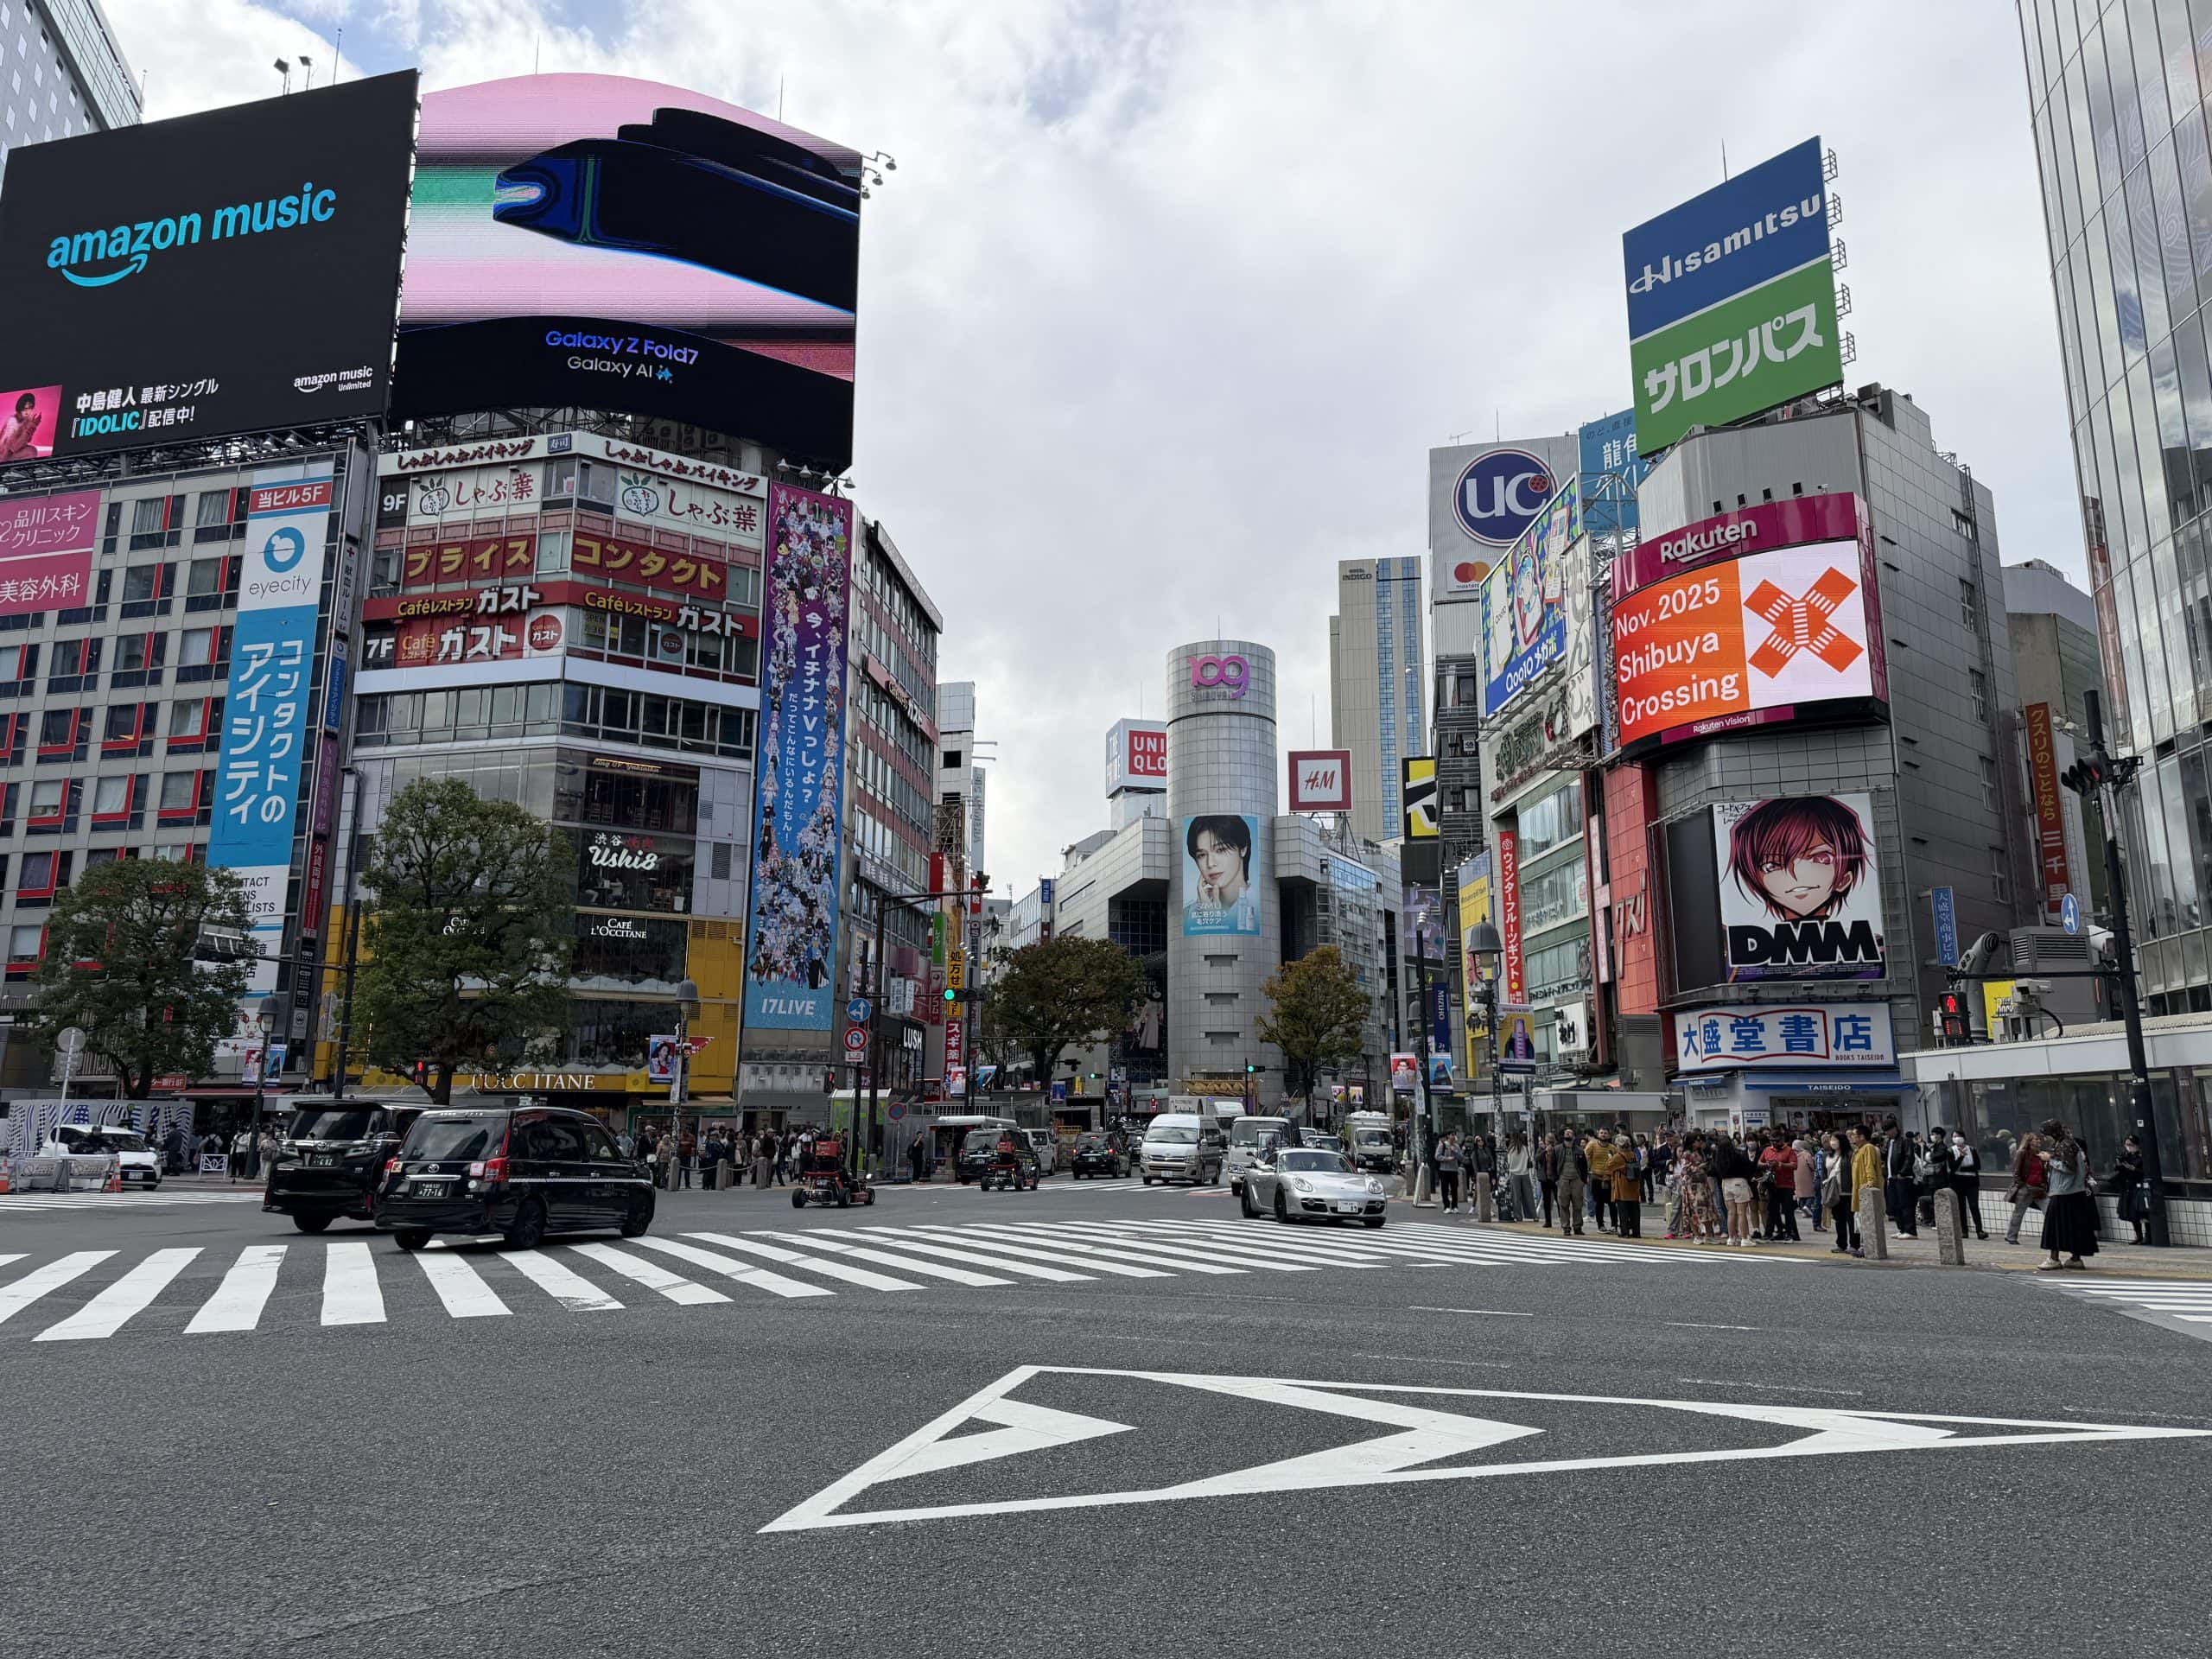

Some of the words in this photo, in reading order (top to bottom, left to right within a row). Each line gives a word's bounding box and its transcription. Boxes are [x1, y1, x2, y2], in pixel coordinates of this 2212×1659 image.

[47, 211, 201, 269] amazon
[212, 182, 337, 239] music
[1630, 193, 1820, 293] Hisamitsu
[546, 330, 623, 355] Galaxy
[626, 336, 639, 353] Z
[643, 340, 700, 365] Fold7
[1644, 302, 1823, 414] サロンパス
[294, 372, 337, 389] amazon
[339, 365, 373, 380] music
[567, 356, 632, 378] Galaxy
[635, 364, 653, 378] AI
[76, 392, 137, 414] 中島健人
[140, 378, 219, 404] 最新シングル
[338, 379, 372, 392] Unlimited
[397, 438, 536, 470] しゃぶしゃぶバイキング
[606, 441, 760, 490] しゃぶしゃぶバイキング
[1603, 432, 1637, 471] 龍角
[258, 486, 323, 508] 当ビル5F
[383, 493, 407, 512] 9F
[455, 473, 534, 505] しゃぶ葉
[14, 504, 92, 527] 品川スキン
[669, 489, 757, 531] しゃぶ葉
[11, 524, 81, 546] クリニック
[1660, 519, 1758, 563] Rakuten
[406, 538, 532, 579] プライス
[574, 538, 721, 591] コンタクト
[0, 573, 80, 603] 美容外科
[249, 575, 312, 599] eyecity
[397, 597, 474, 616] Caféレストラン
[477, 586, 540, 614] ガスト
[585, 592, 671, 620] Caféレストラン
[677, 606, 743, 637] ガスト
[367, 639, 394, 658] 7F
[402, 634, 435, 650] Café
[438, 625, 516, 661] ガスト
[532, 631, 560, 641] ガスト
[663, 640, 681, 650] ガスト
[401, 650, 434, 660] レストラン
[1619, 632, 1719, 683] Shibuya
[1189, 656, 1249, 698] 109
[1506, 658, 1533, 693] Qoo10
[1622, 672, 1738, 726] Crossing
[226, 643, 274, 824] アイシティ
[261, 639, 303, 823] コンタクトの
[1694, 719, 1724, 732] Rakuten
[1725, 715, 1750, 728] Vision
[1135, 737, 1164, 753] UNI
[1135, 755, 1166, 772] QLO
[2031, 709, 2056, 821] クスリのことなら
[1304, 770, 1335, 791] H&M
[588, 845, 659, 871] Ushi8
[2041, 830, 2068, 902] 三千里
[238, 890, 257, 899] ENS
[1503, 852, 1519, 980] ウィンターフルーツギフト
[1729, 920, 1881, 966] DMM
[761, 999, 817, 1015] 17LIVE
[903, 1027, 923, 1051] LUSH
[1683, 1014, 1872, 1058] 大盛堂書店
